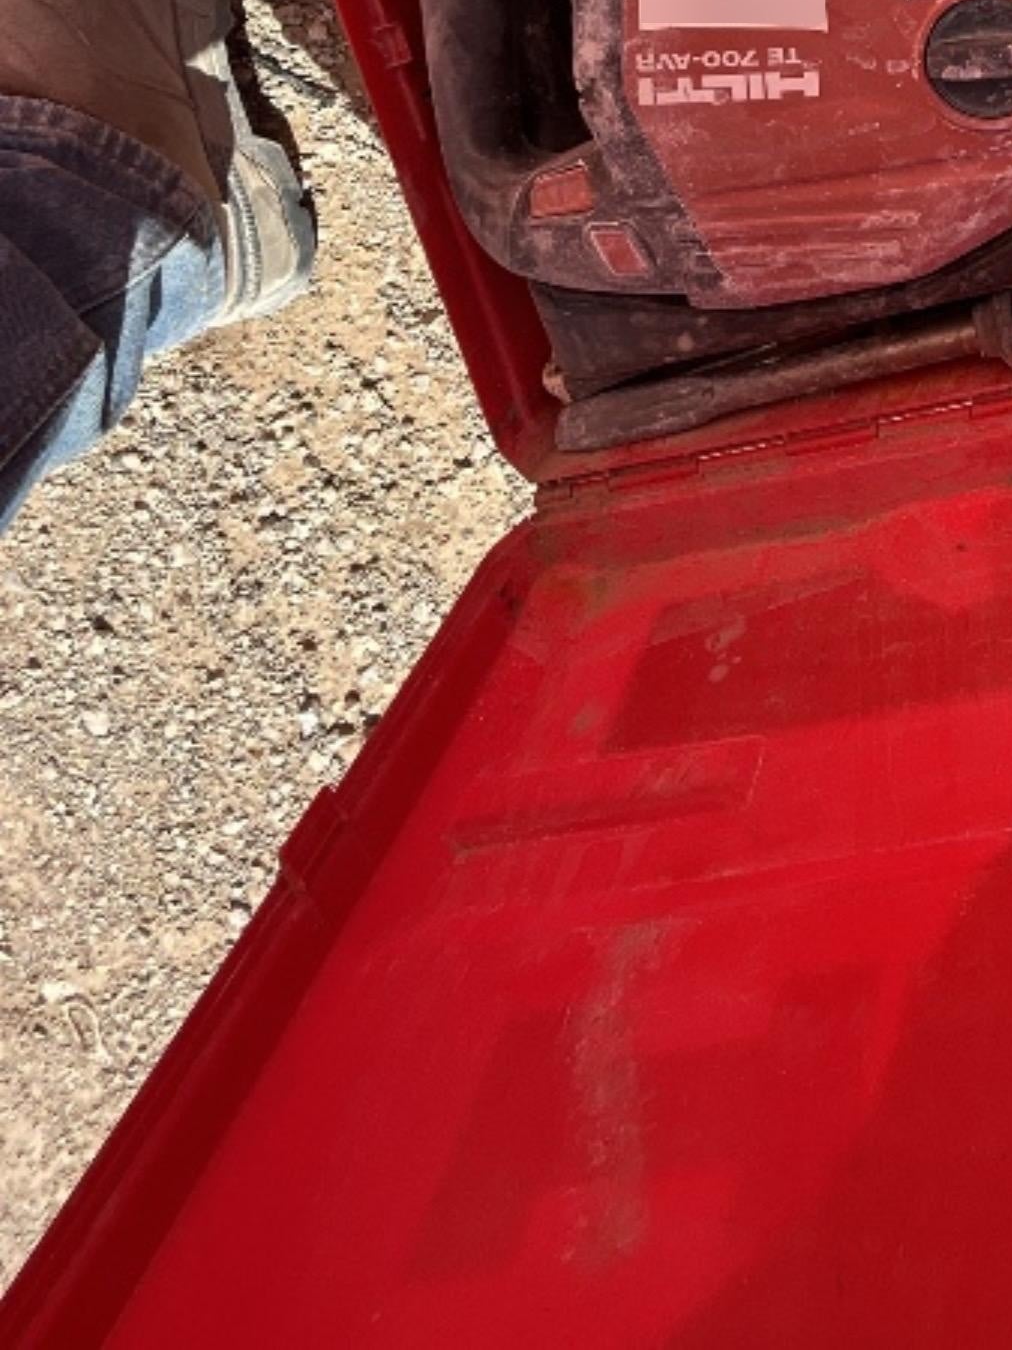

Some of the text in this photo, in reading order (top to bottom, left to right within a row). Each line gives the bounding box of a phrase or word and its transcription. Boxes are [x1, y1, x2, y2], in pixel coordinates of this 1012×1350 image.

[636, 47, 800, 71] TE 700-AVR
[638, 70, 820, 106] HILTI
